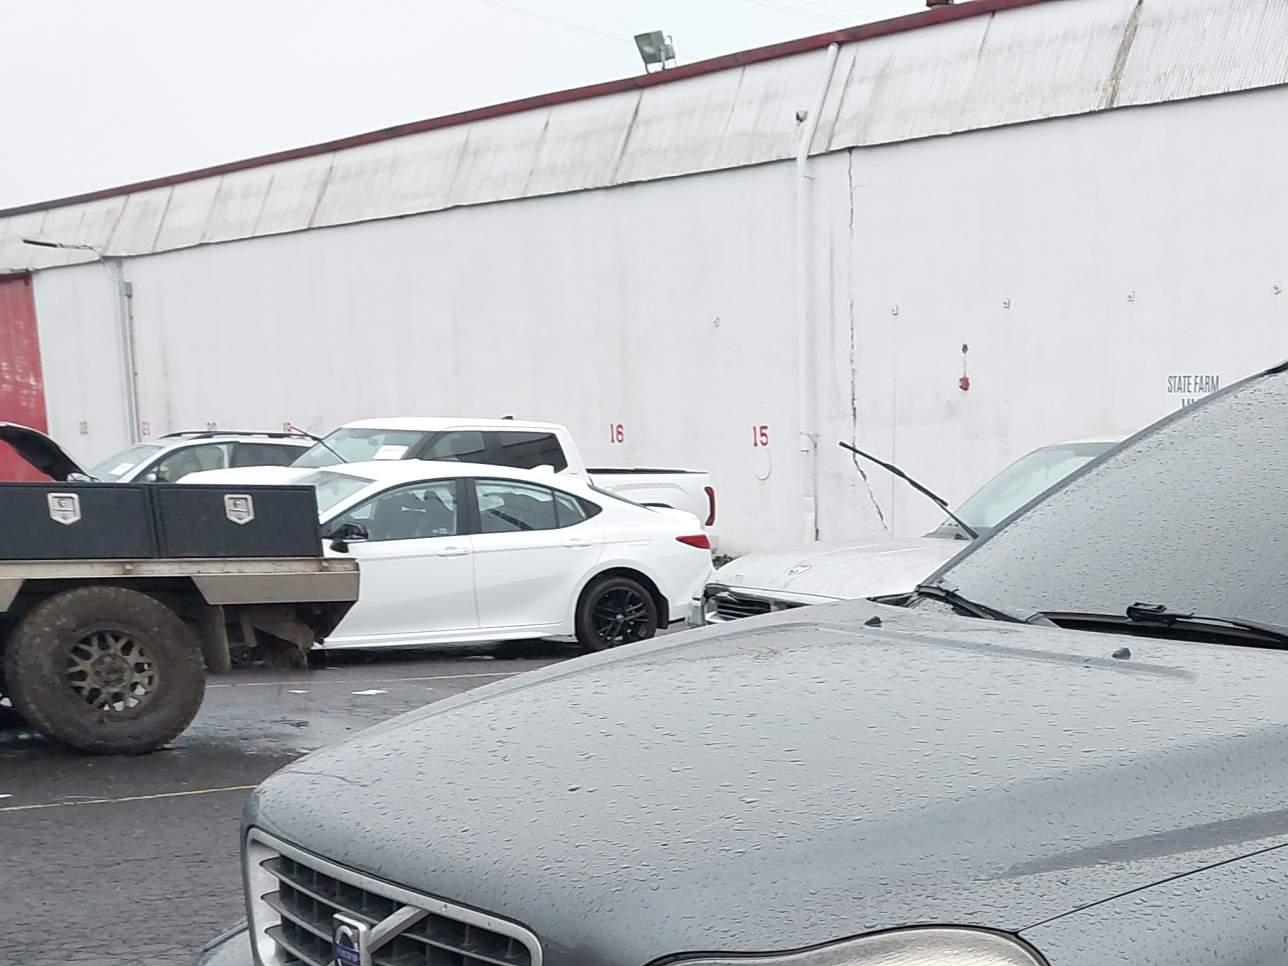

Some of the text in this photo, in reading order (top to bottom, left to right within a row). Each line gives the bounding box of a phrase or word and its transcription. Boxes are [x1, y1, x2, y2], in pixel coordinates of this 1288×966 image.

[1167, 375, 1219, 393] STATE FARM
[610, 423, 625, 444] 16
[752, 425, 769, 447] 15
